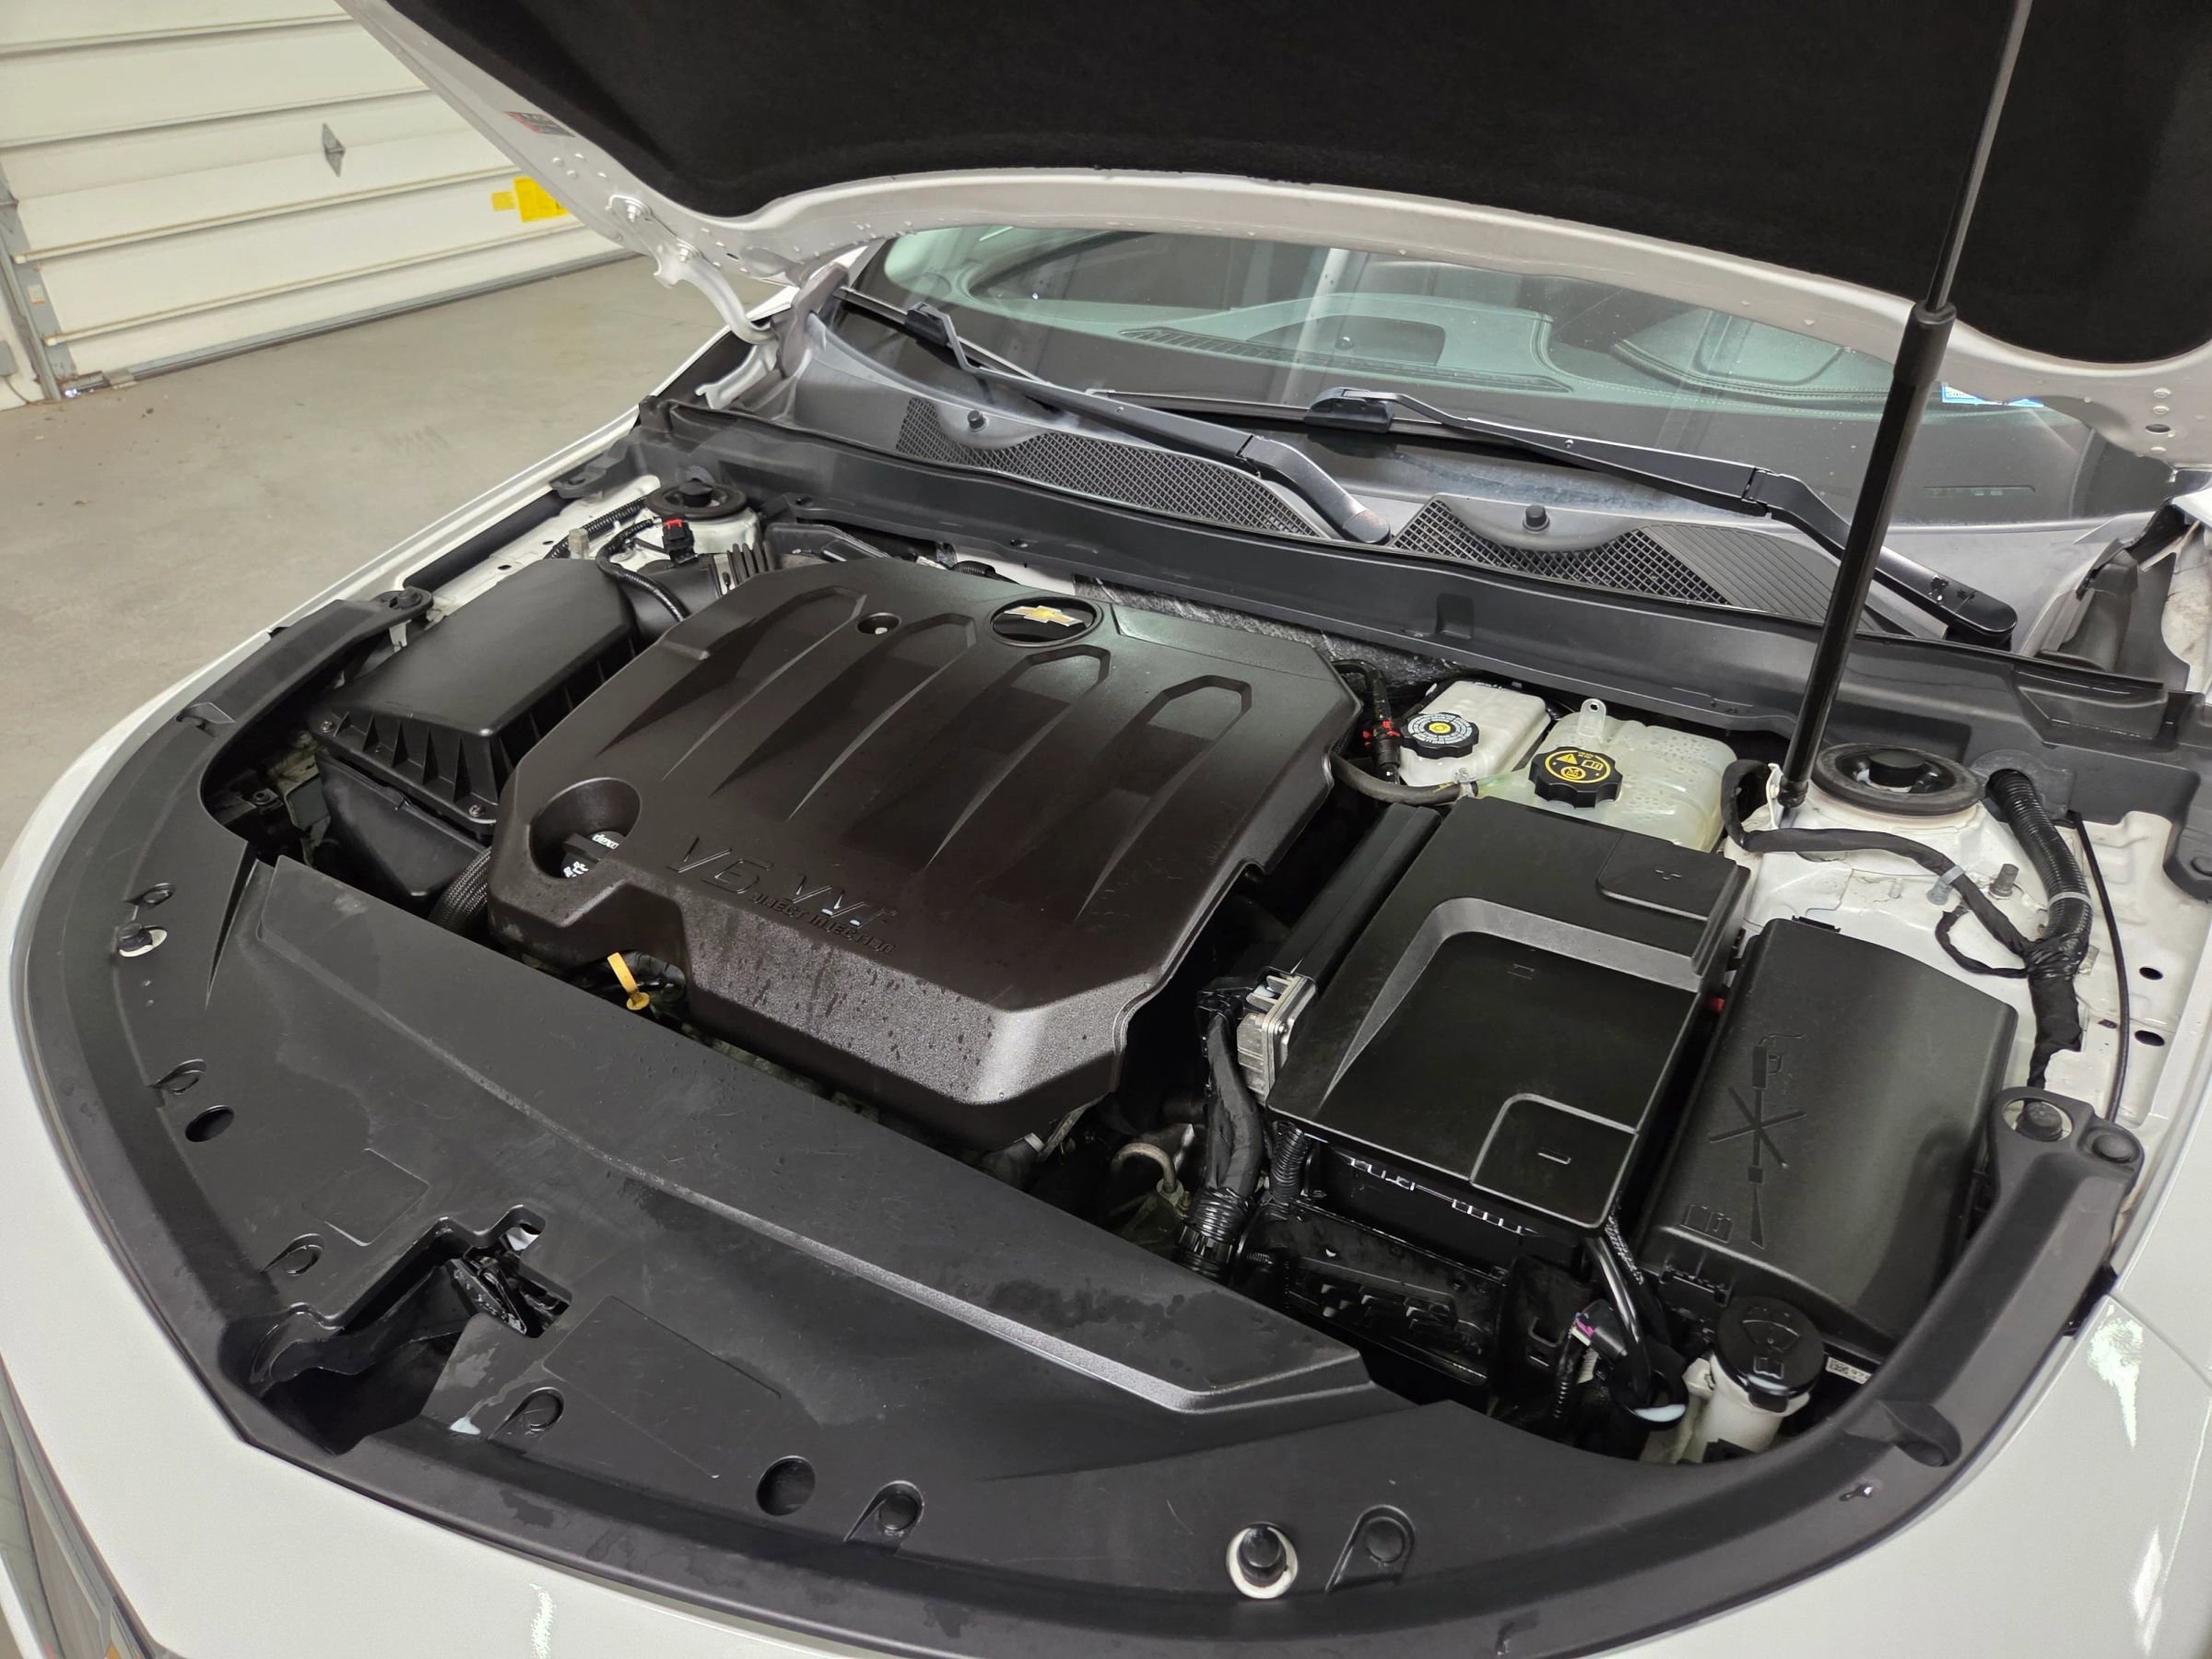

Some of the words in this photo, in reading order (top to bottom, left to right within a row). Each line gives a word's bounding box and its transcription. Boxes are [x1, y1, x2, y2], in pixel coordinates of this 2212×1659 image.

[592, 834, 619, 850] dexo
[665, 836, 775, 895] V6
[808, 914, 899, 953] INJECTION
